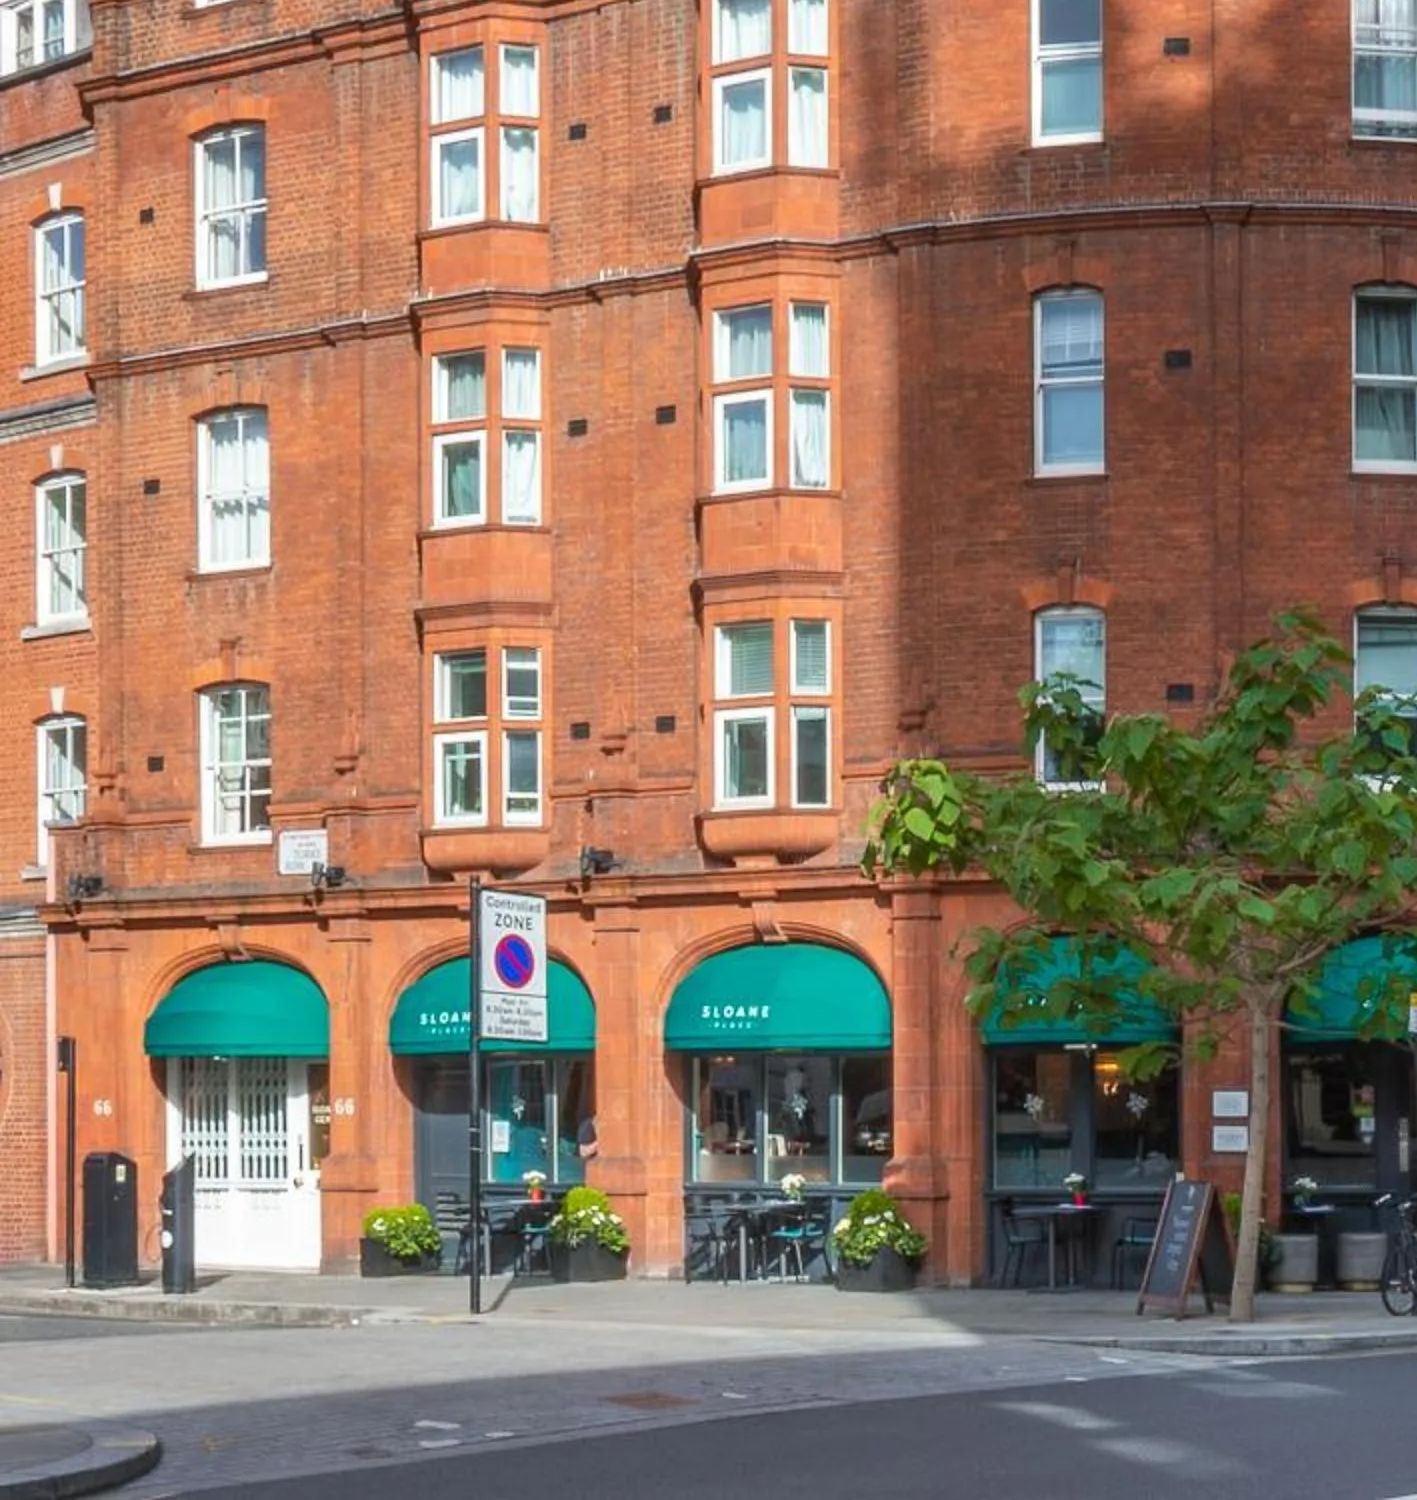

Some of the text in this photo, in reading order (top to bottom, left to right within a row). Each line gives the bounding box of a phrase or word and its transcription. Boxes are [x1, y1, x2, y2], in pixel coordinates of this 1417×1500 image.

[495, 913, 533, 931] ZONE
[420, 1011, 471, 1025] SLOAN
[701, 1005, 769, 1018] SLOANE
[93, 1099, 112, 1116] 66
[334, 1097, 355, 1115] 66
